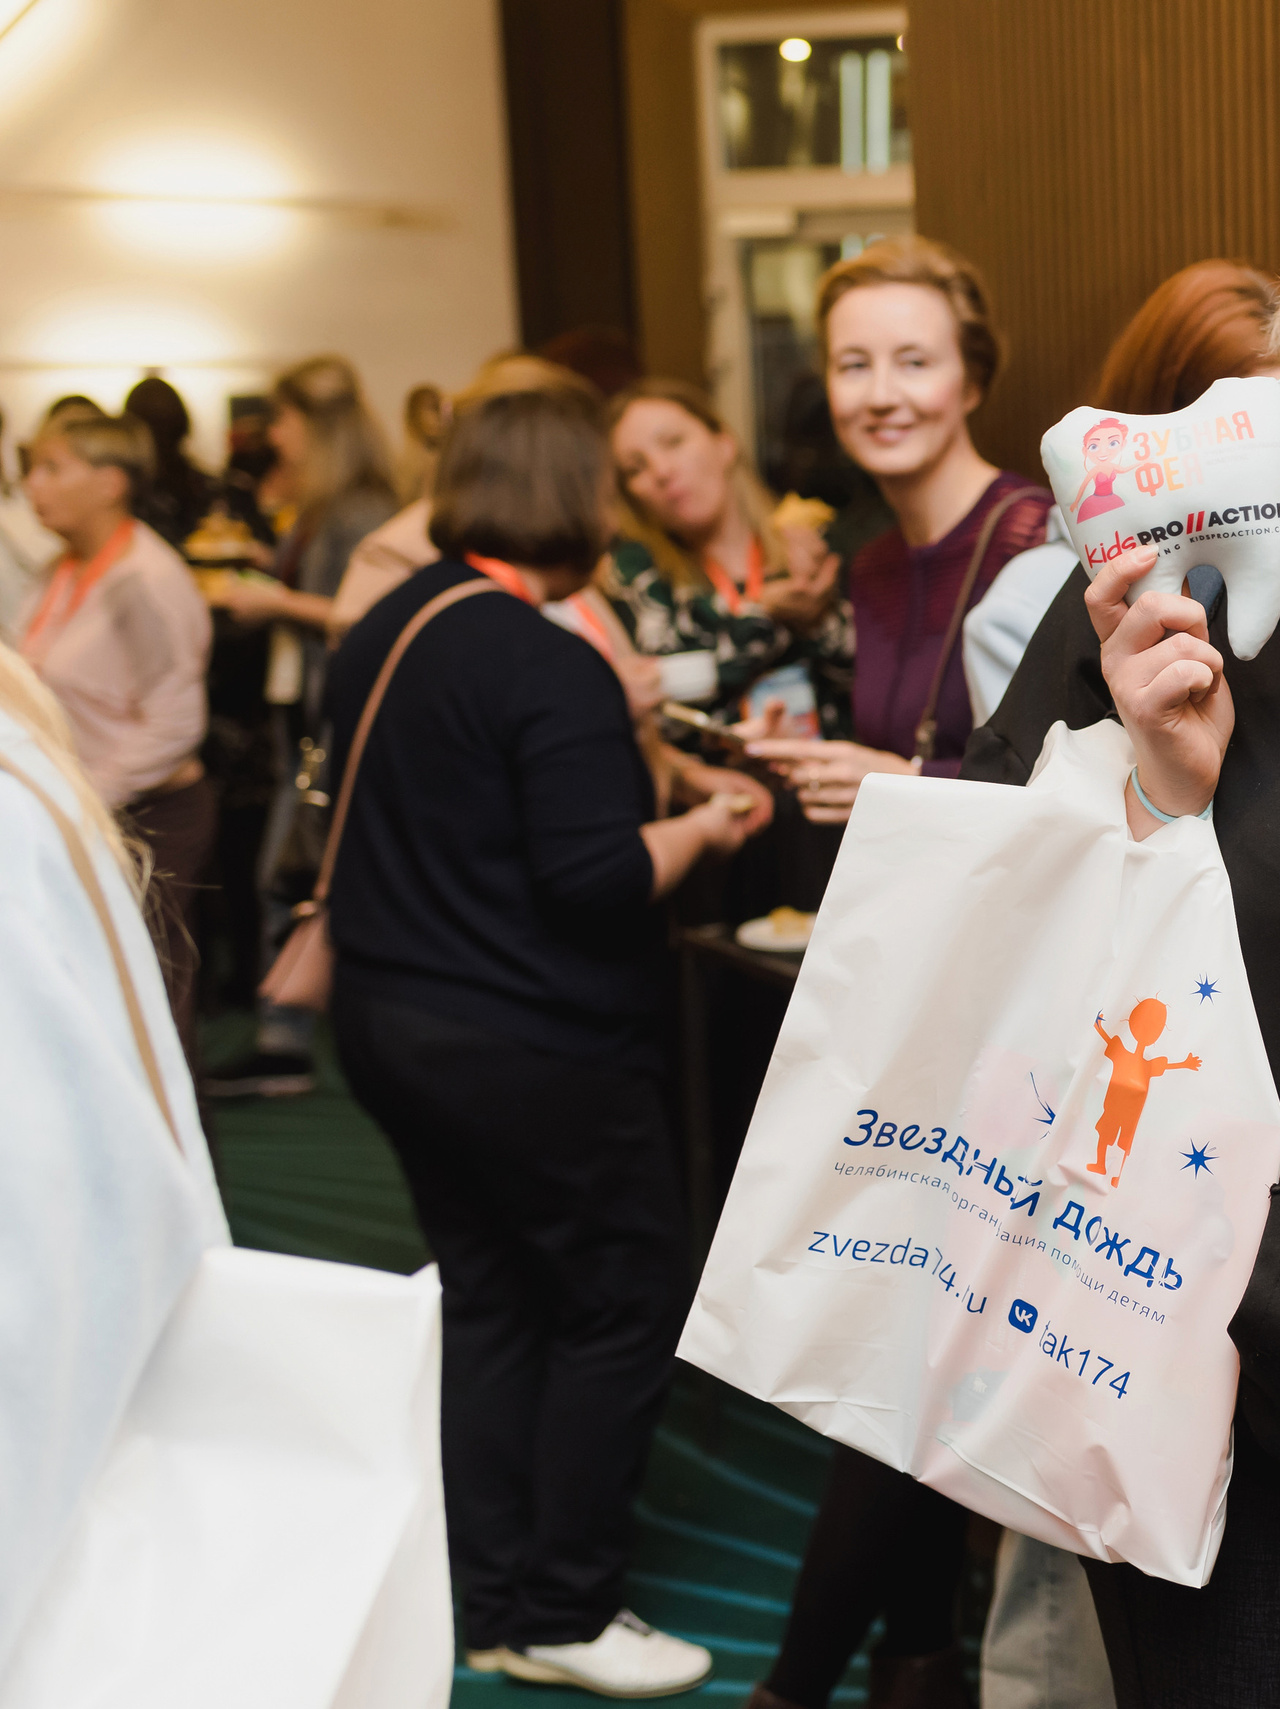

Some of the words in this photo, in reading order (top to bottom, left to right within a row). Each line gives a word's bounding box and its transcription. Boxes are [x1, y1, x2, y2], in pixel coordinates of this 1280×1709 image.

[1132, 410, 1255, 462] ЗУБНАЯ
[1134, 453, 1205, 497] ФЕЯ
[834, 1161, 951, 1194] Челябинская
[1106, 1289, 1166, 1325] детям
